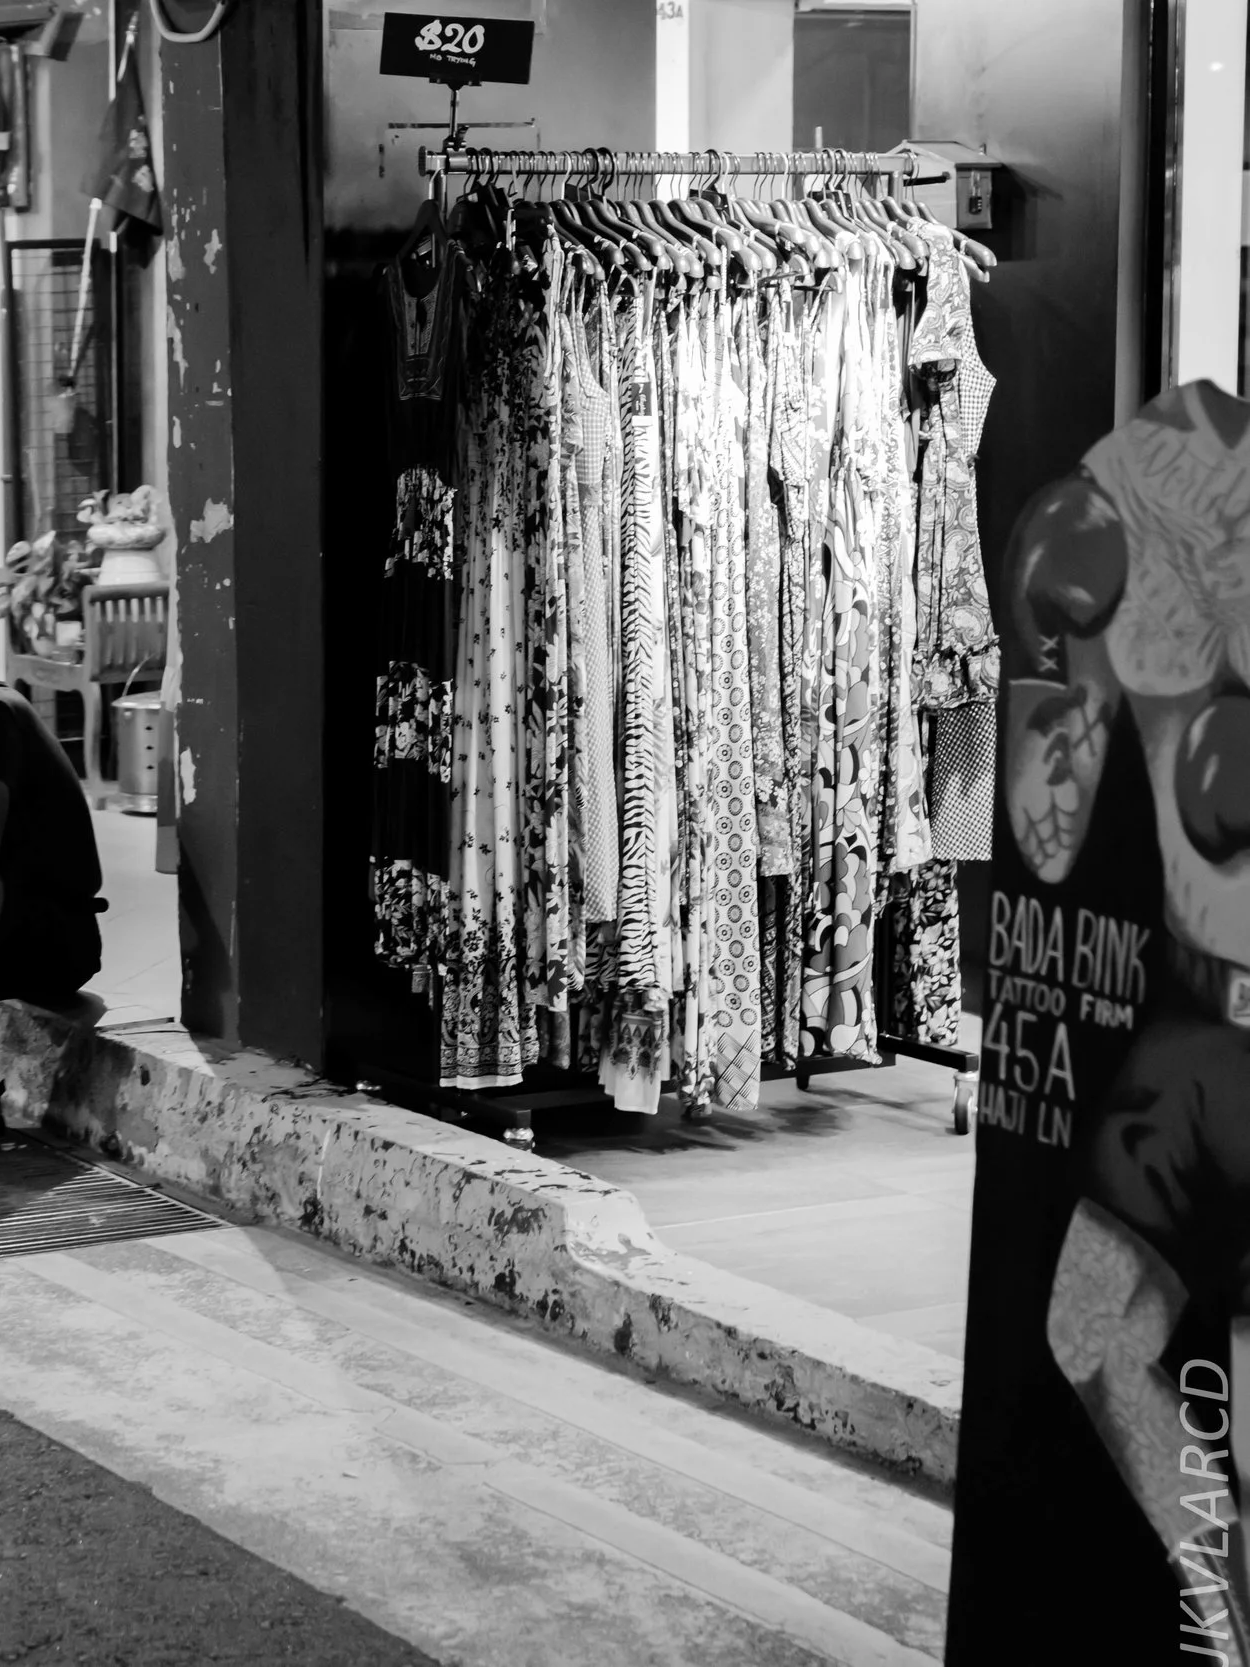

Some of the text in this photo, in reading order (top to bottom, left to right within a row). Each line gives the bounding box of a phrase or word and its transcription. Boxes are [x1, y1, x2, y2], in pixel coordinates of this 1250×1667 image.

[415, 19, 485, 54] $20
[430, 53, 476, 68] NO TRYING
[989, 890, 1150, 1003] BADA BINK
[987, 967, 1134, 1030] TATTOO FIRM
[979, 1080, 1073, 1149] HAJI LN
